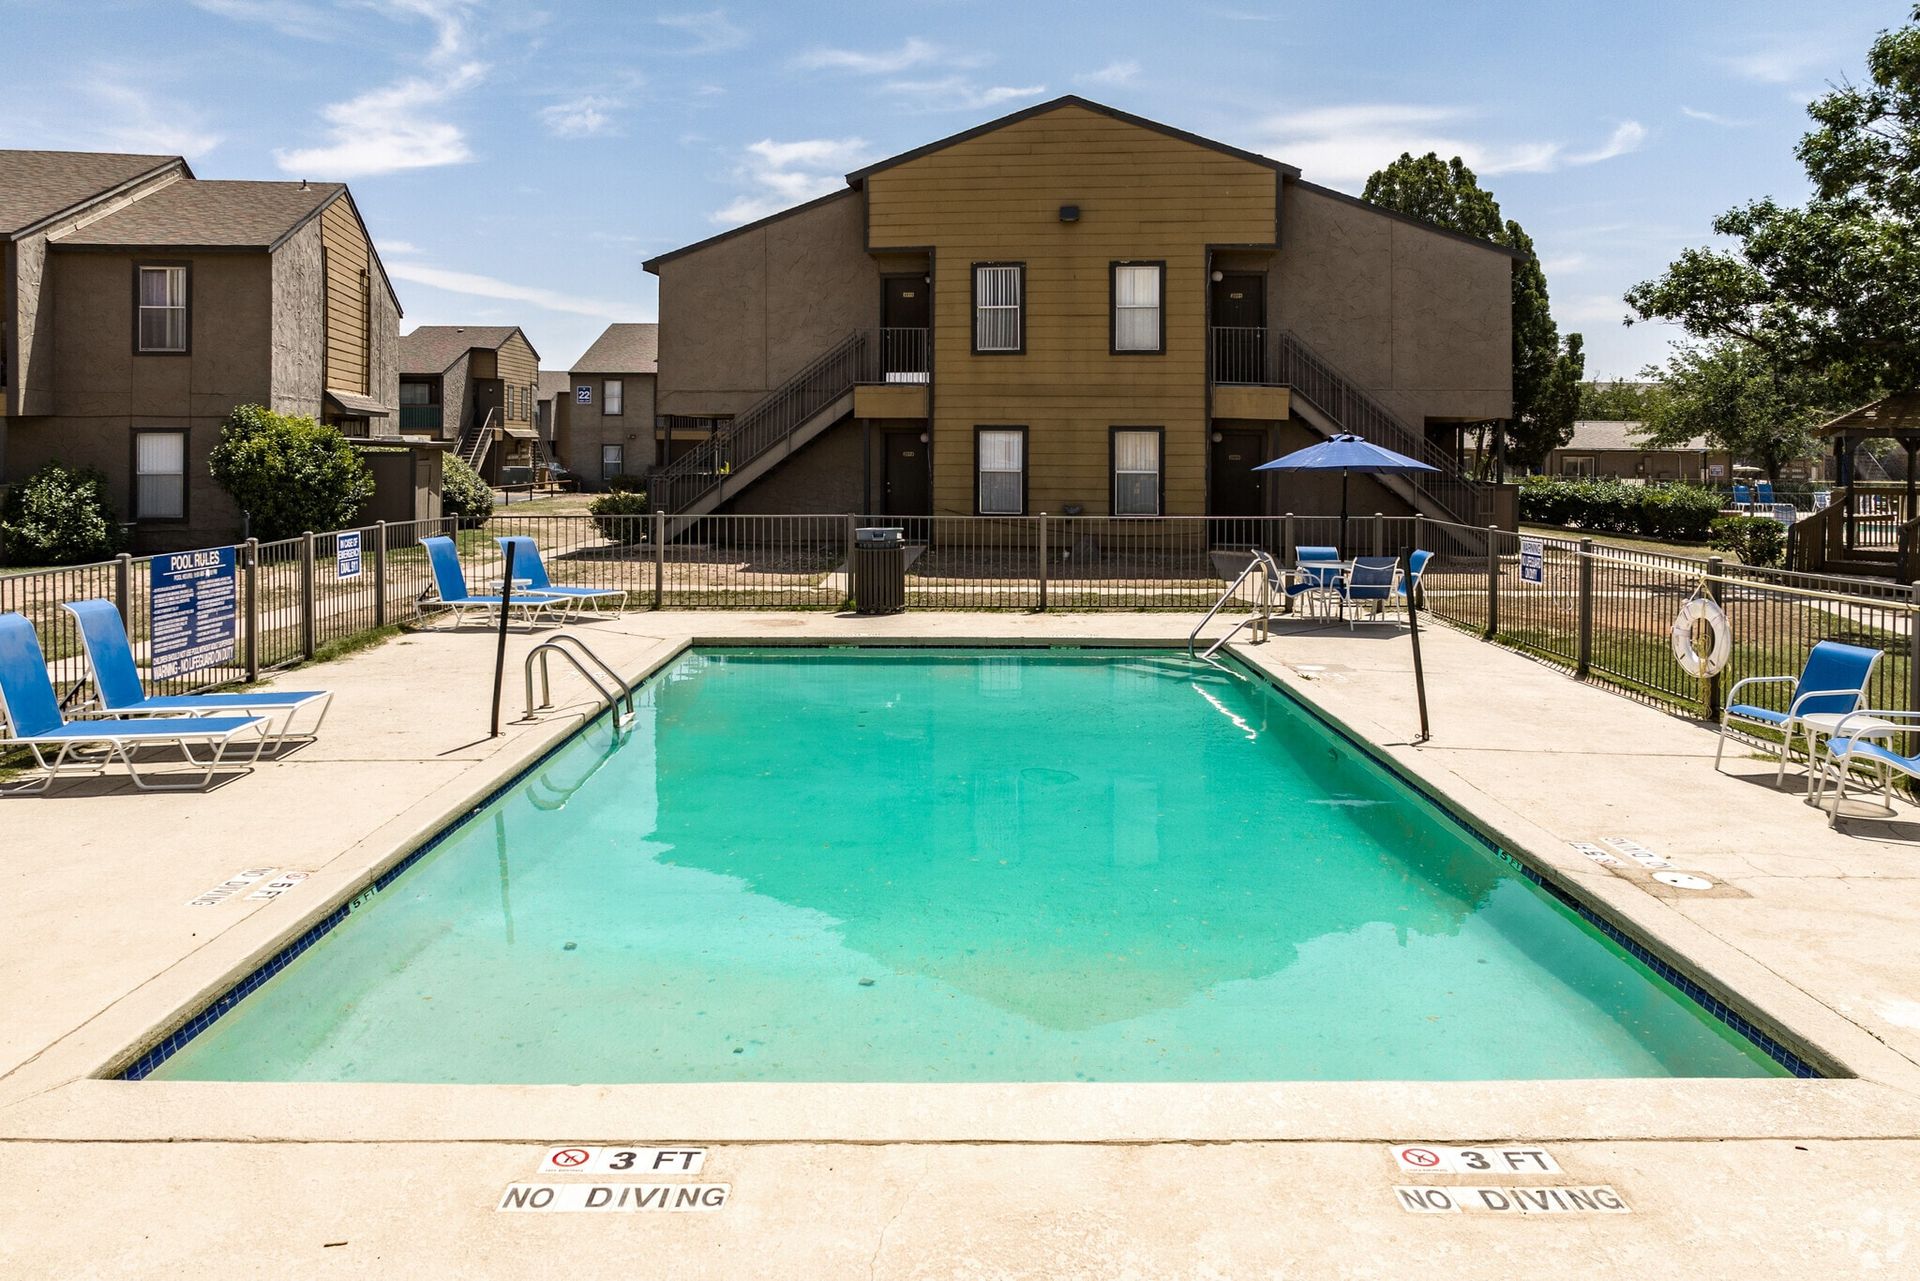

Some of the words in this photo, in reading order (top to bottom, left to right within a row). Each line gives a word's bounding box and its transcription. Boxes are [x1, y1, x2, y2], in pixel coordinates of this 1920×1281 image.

[578, 390, 590, 399] 22
[171, 554, 193, 570] POOL
[194, 550, 220, 567] RULES
[153, 661, 178, 680] WARNING
[181, 658, 188, 672] NO
[189, 651, 215, 671] LIFEGUARD
[352, 898, 361, 909] 5
[363, 886, 375, 901] FT
[609, 1151, 637, 1171] 3
[652, 1151, 702, 1171] FT
[1461, 1151, 1491, 1171] 3
[1502, 1151, 1549, 1171] FT
[502, 1187, 555, 1209] NO
[584, 1187, 725, 1209] DIVING
[1399, 1189, 1452, 1210] NO
[1477, 1189, 1626, 1211] DIVING
